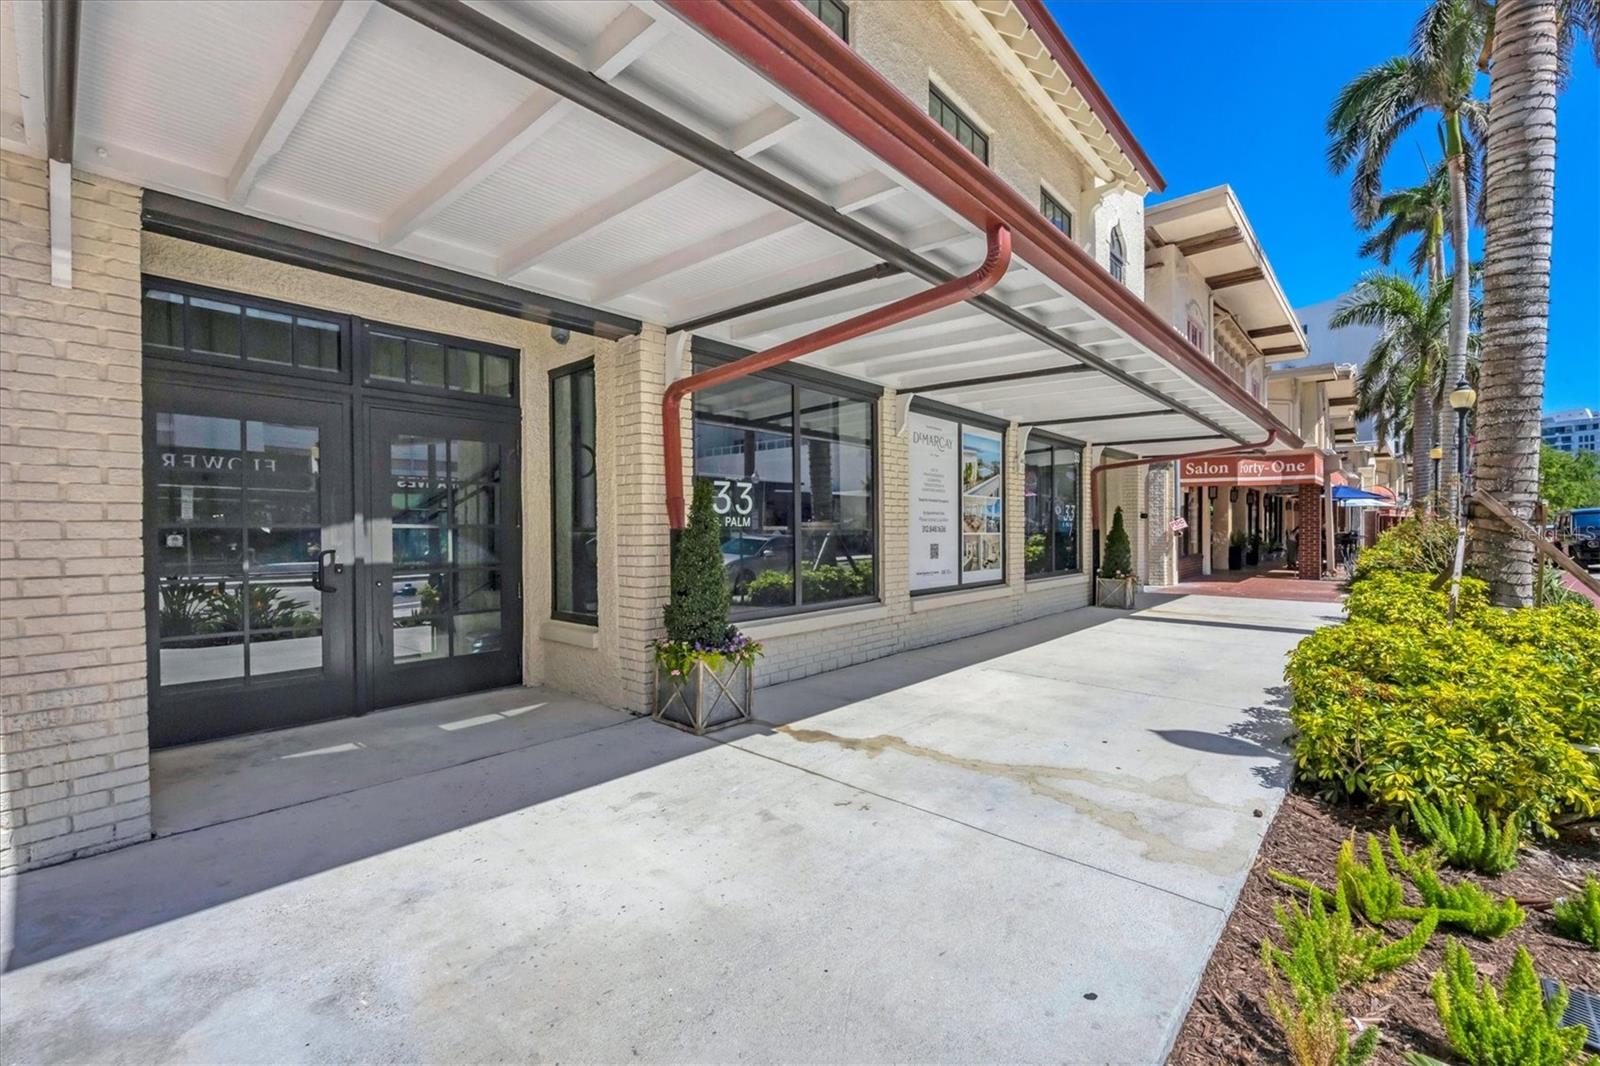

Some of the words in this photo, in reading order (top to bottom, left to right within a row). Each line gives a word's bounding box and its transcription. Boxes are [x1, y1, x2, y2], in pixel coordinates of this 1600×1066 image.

[1185, 461, 1229, 475] Salon
[713, 480, 753, 515] 33
[725, 516, 751, 527] PALM
